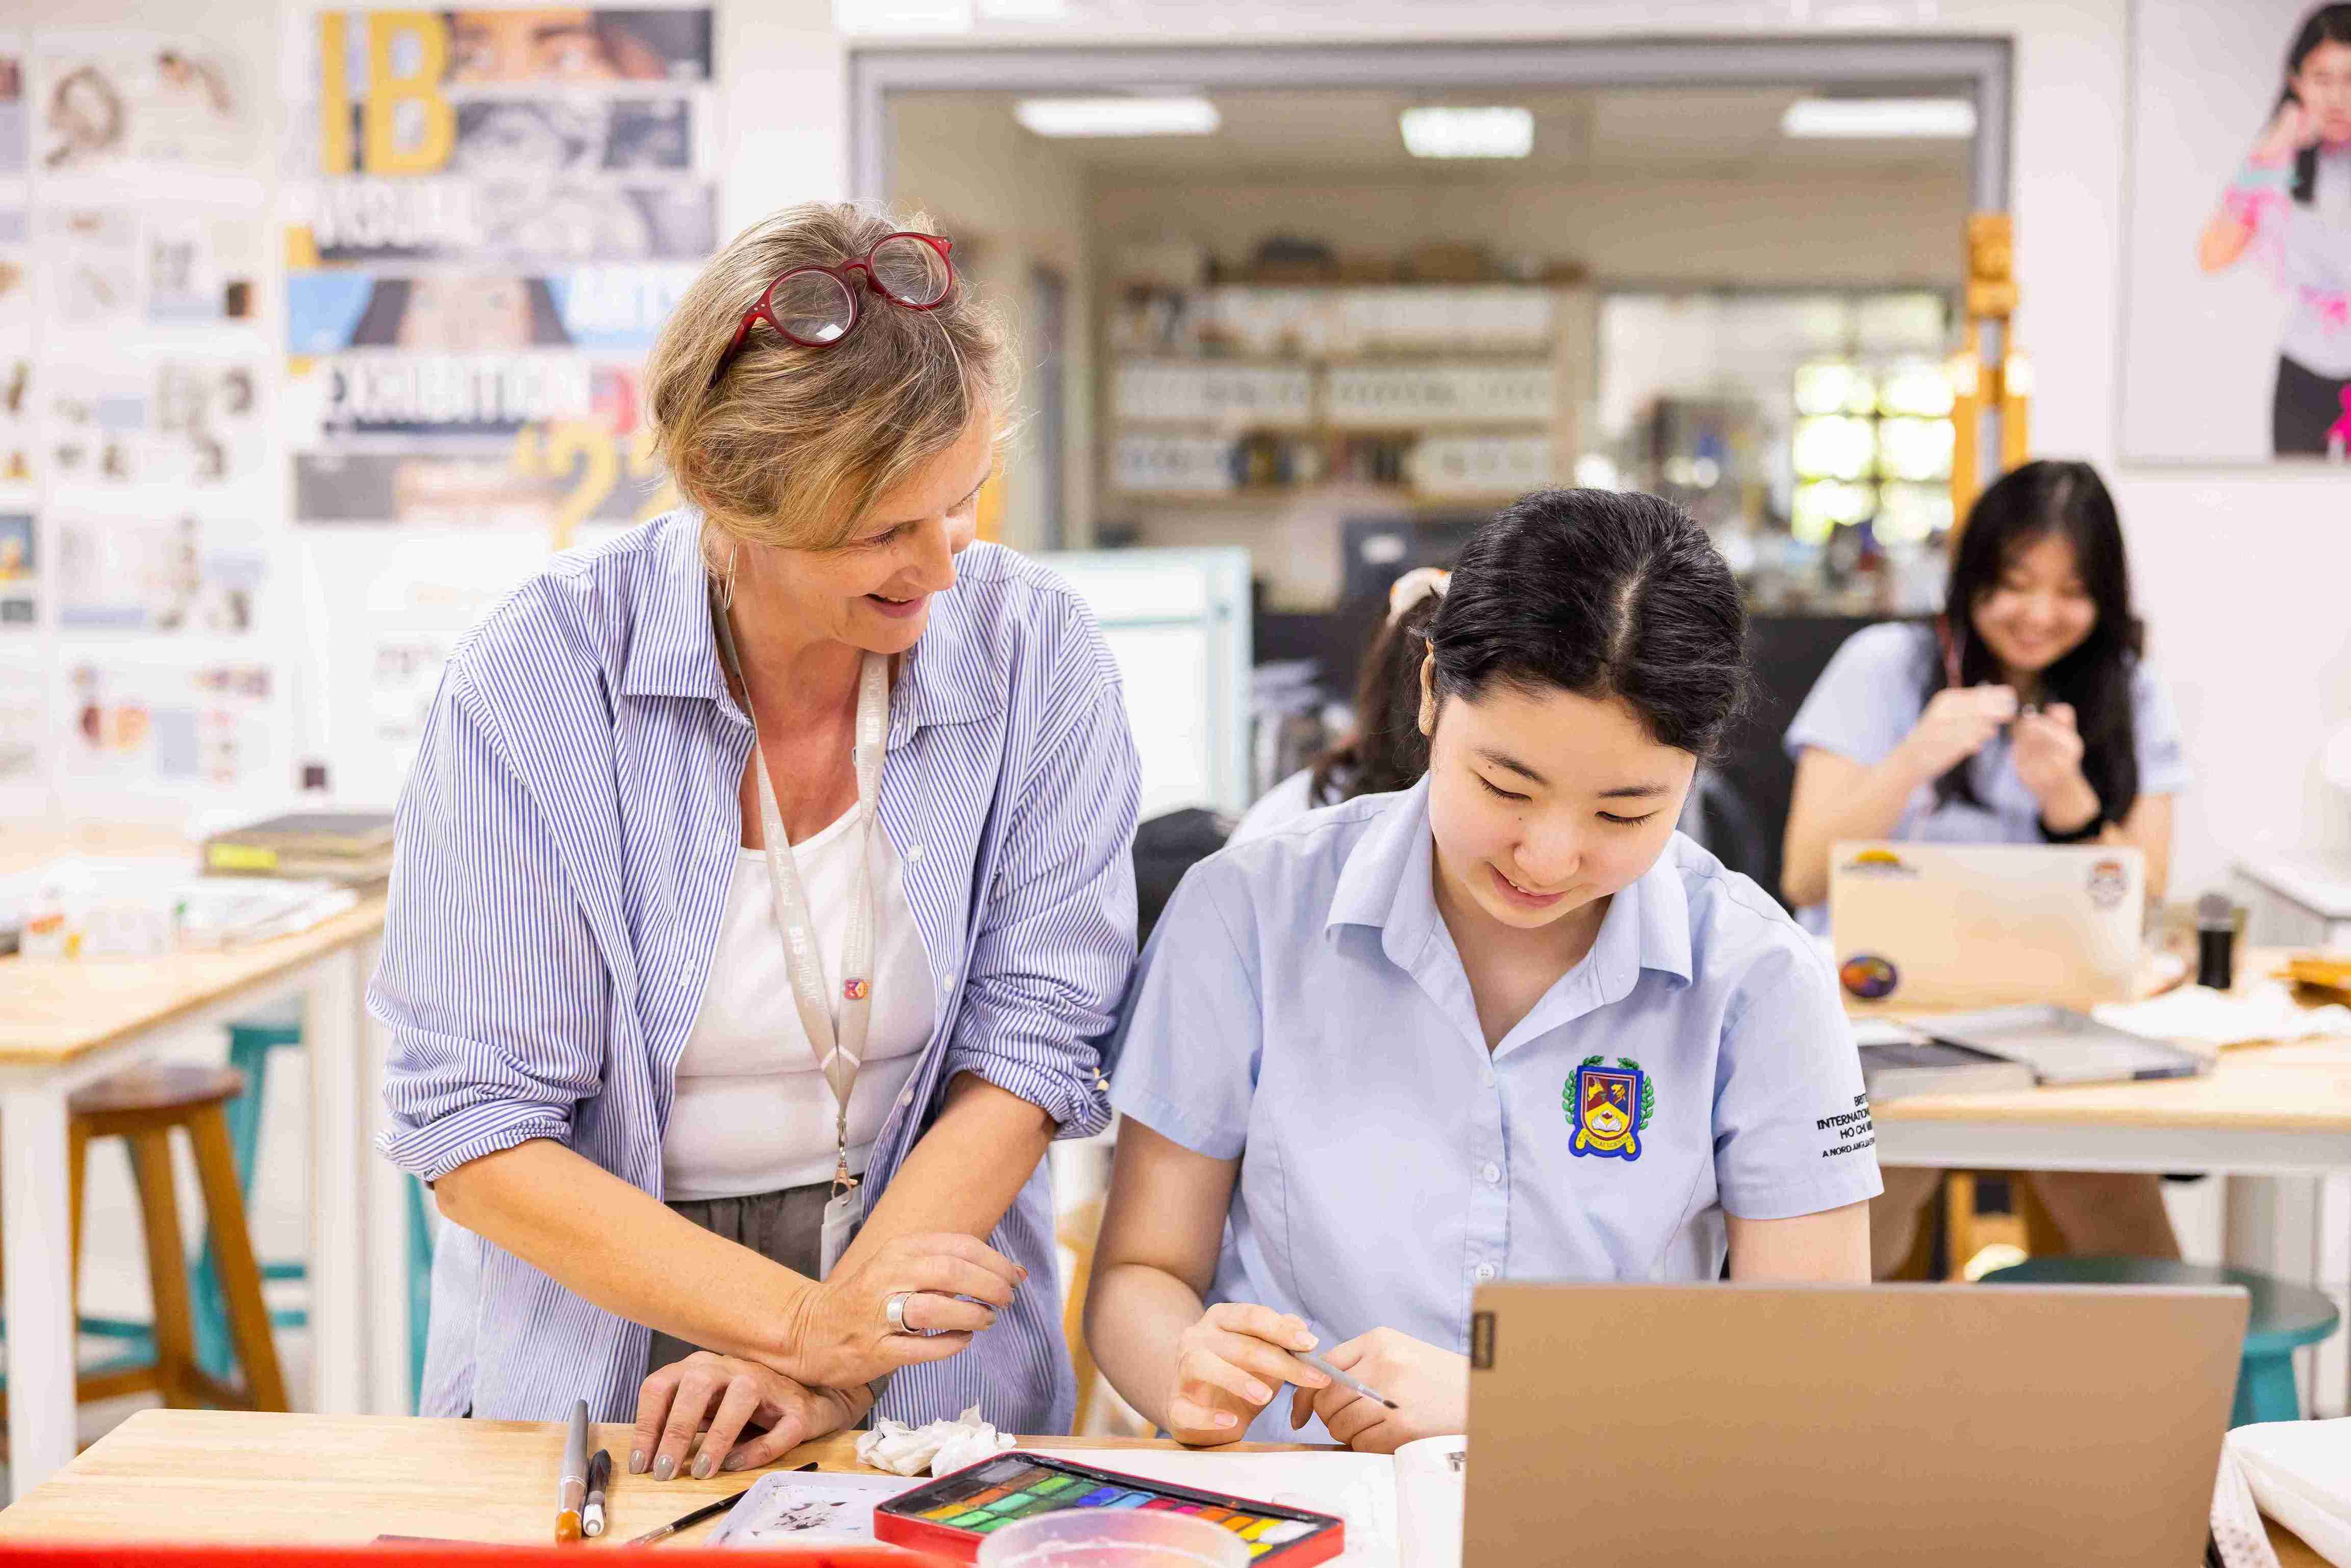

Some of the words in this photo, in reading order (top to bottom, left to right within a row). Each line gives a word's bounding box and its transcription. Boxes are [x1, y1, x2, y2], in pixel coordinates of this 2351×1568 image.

[320, 8, 457, 174] IB
[1840, 1127, 1854, 1139] HO
[1830, 1145, 1852, 1156] NORD
